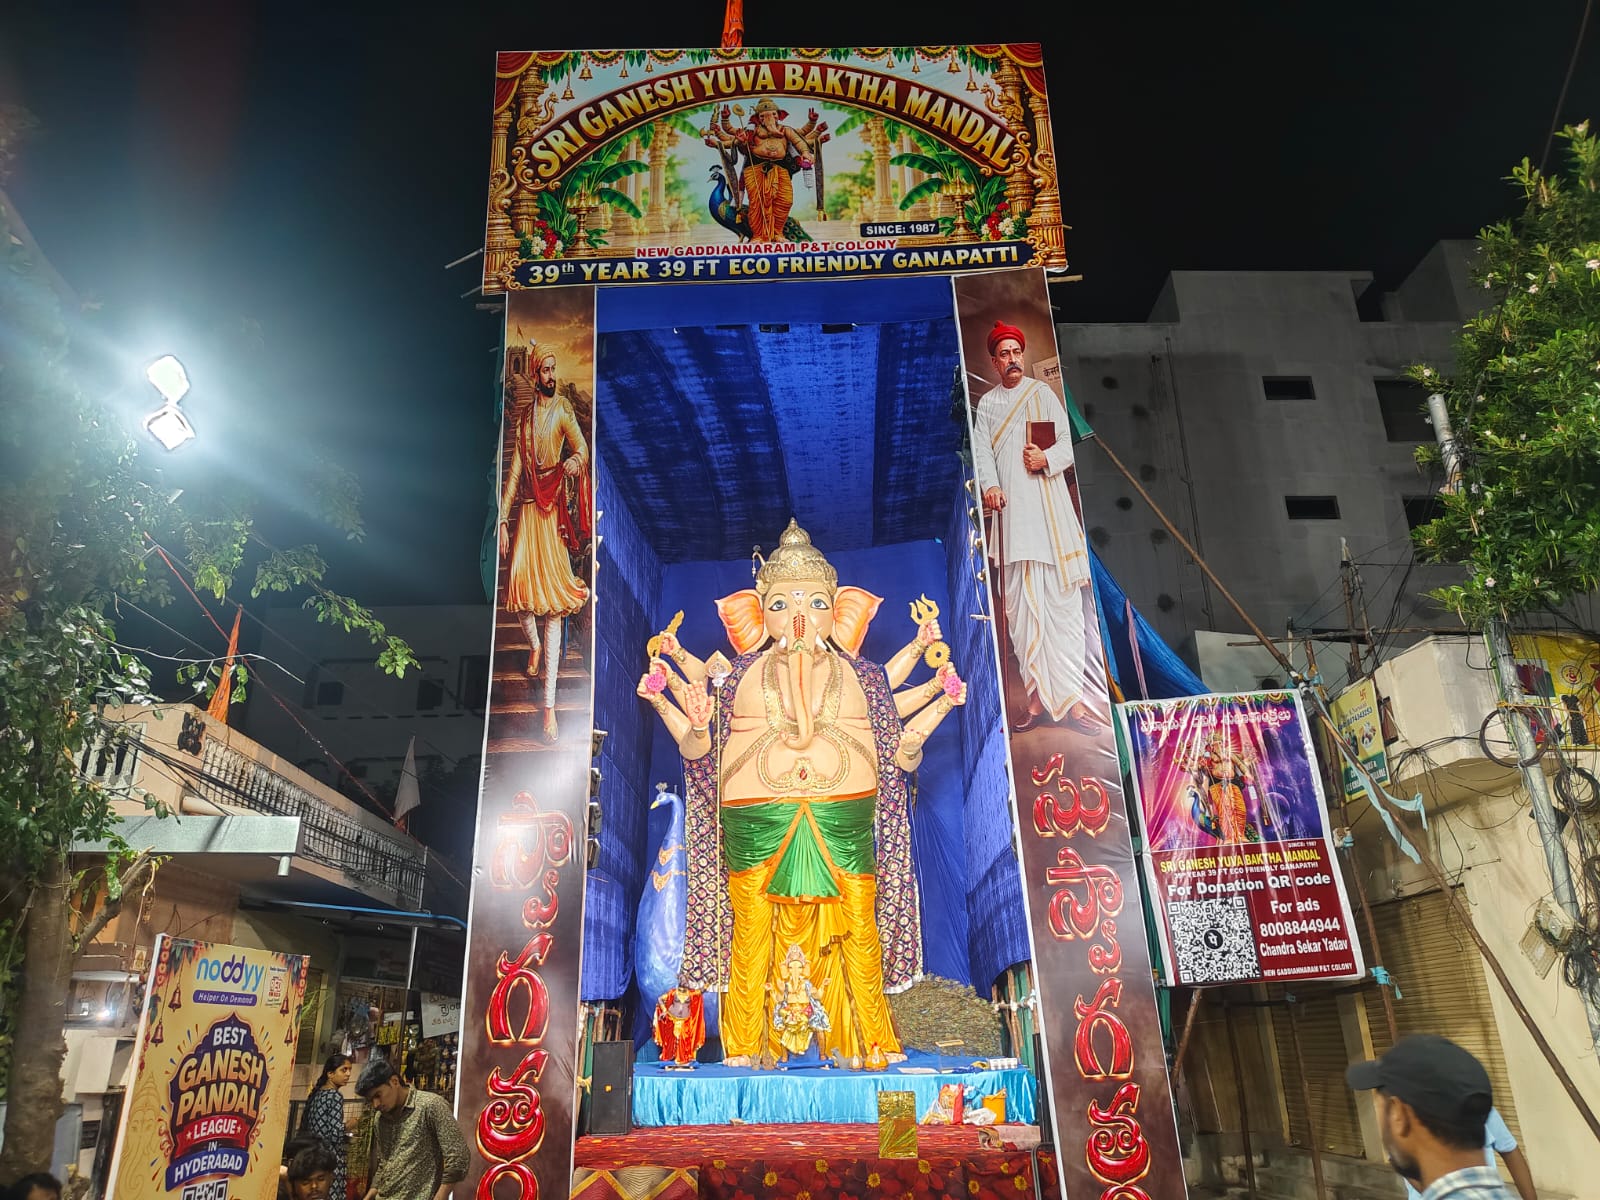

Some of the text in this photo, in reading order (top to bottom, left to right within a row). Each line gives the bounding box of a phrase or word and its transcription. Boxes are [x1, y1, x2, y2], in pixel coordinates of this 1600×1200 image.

[531, 63, 1016, 178] SRI GANESH YUVA BAKTHA MANDAL
[866, 223, 936, 235] SINCE: 1987
[636, 239, 897, 258] NEW GADDIANNARAM P&T COLONY
[528, 245, 1019, 284] 39th YEAR 39 FT ECO FRIENDLY GANAPATTI
[1160, 849, 1321, 873] SRI GANESH YUVA BAKTHA MANDAL
[1187, 869, 1206, 879] YEAR
[1208, 869, 1216, 877] 39
[1218, 868, 1228, 876] FT
[1230, 866, 1244, 875] ECO
[1246, 864, 1278, 874] FRIENDLY
[1167, 873, 1331, 897] For Donation QR code
[1270, 898, 1320, 914] For ads
[1260, 917, 1340, 937] 8008844944
[1260, 937, 1348, 957] Chandra Sekar Yadav
[196, 954, 264, 992] noddyy
[1263, 969, 1276, 977] NEW
[1331, 963, 1353, 971] COLONY
[198, 992, 219, 1002] Helper
[220, 994, 229, 1003] On
[229, 994, 253, 1004] Demand
[212, 1026, 247, 1047] BEST
[178, 1049, 264, 1092] GANESH
[176, 1082, 258, 1127] PANDAL
[193, 1119, 238, 1140] LEAGUE
[207, 1141, 217, 1152] IN
[174, 1154, 243, 1183] HYDERABAD
